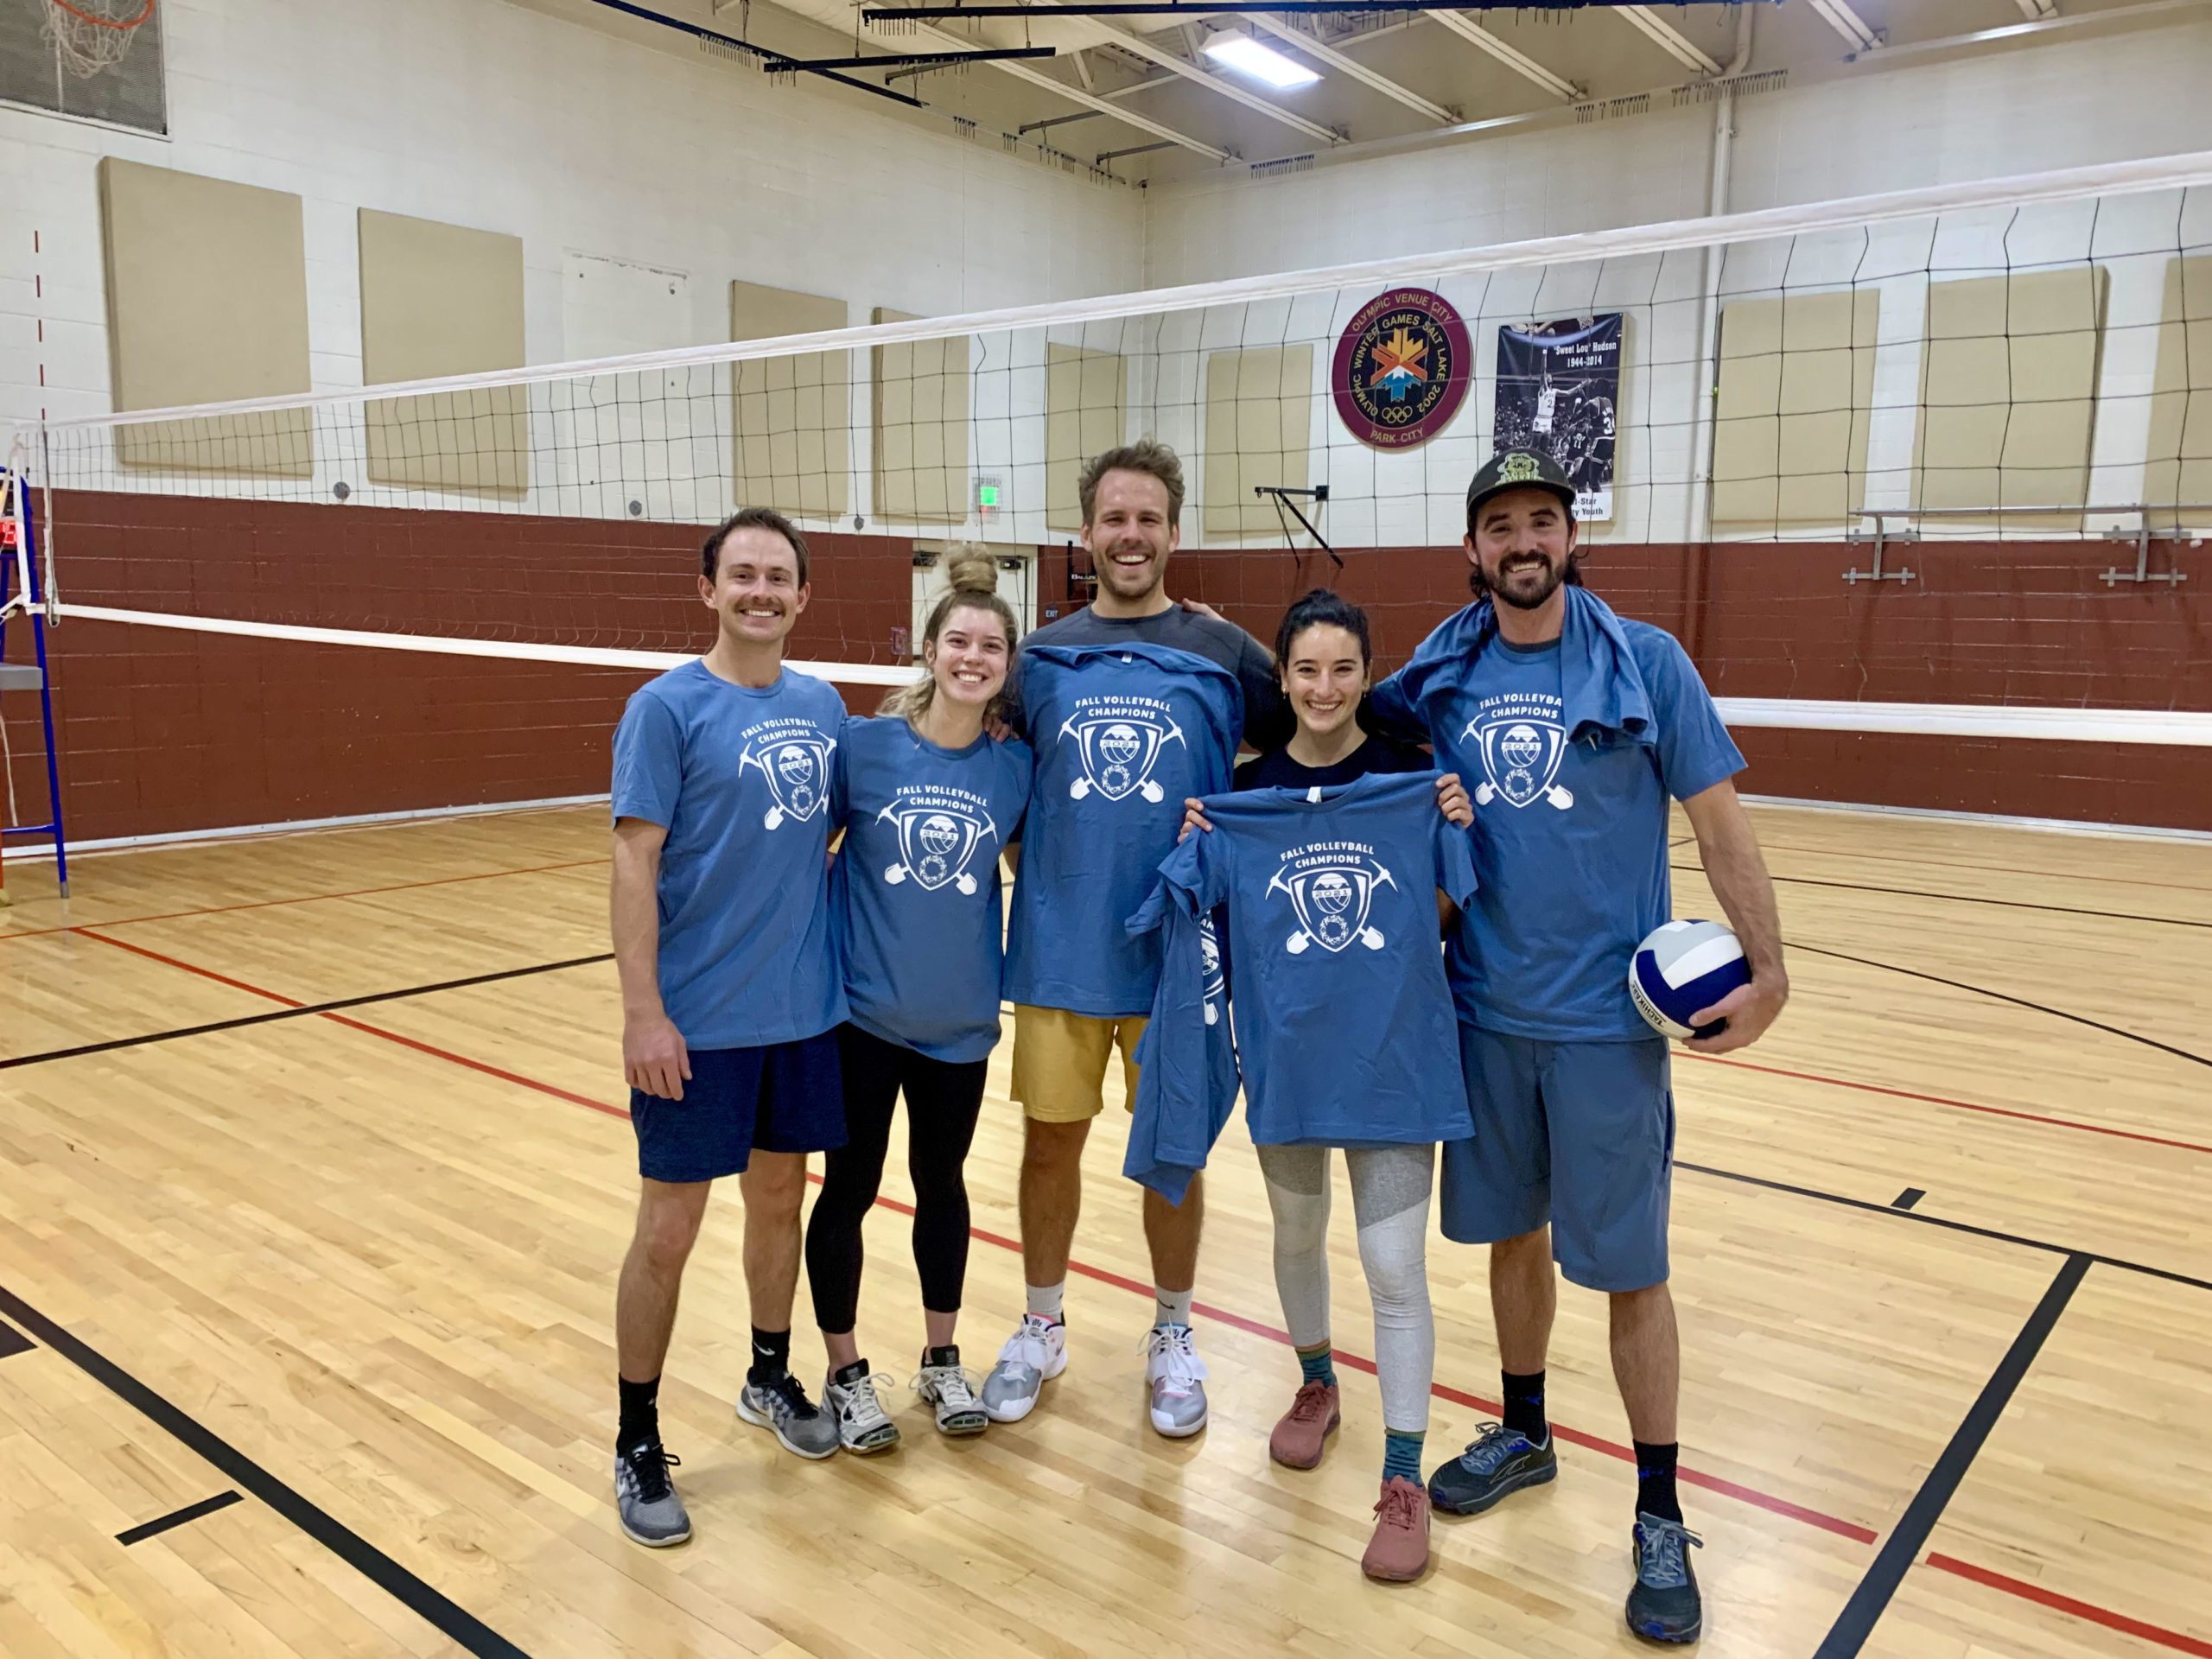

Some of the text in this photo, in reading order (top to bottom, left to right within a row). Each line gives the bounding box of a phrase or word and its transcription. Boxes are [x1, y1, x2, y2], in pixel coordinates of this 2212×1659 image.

[1352, 293, 1453, 332] OLYMPIC VENUE CITY
[1592, 341, 1617, 353] Hudson
[1353, 314, 1447, 416] OLYMPIC WINTER GAMES SALT LAKE 2002
[1567, 355, 1602, 368] 1944-2014
[1370, 427, 1424, 443] PARK CITY
[1582, 507, 1604, 516] Youth
[1075, 696, 1171, 713] FALL VOLLEYBALL
[1479, 693, 1562, 710] FALL VOLLEYBA
[1088, 708, 1156, 720] CHAMPIONS
[1491, 706, 1559, 719] CHAMPIONS
[741, 718, 817, 740] FALL VOLLEYBALL
[757, 728, 810, 744] CHAMPIONS
[896, 785, 988, 807] FALL VOLLEYBALL
[909, 797, 974, 813] CHAMPIONS
[1280, 842, 1375, 861] FALL VOLLEYBALL
[1294, 855, 1361, 868] CHAMPIONS
[1315, 889, 1348, 898] 2021
